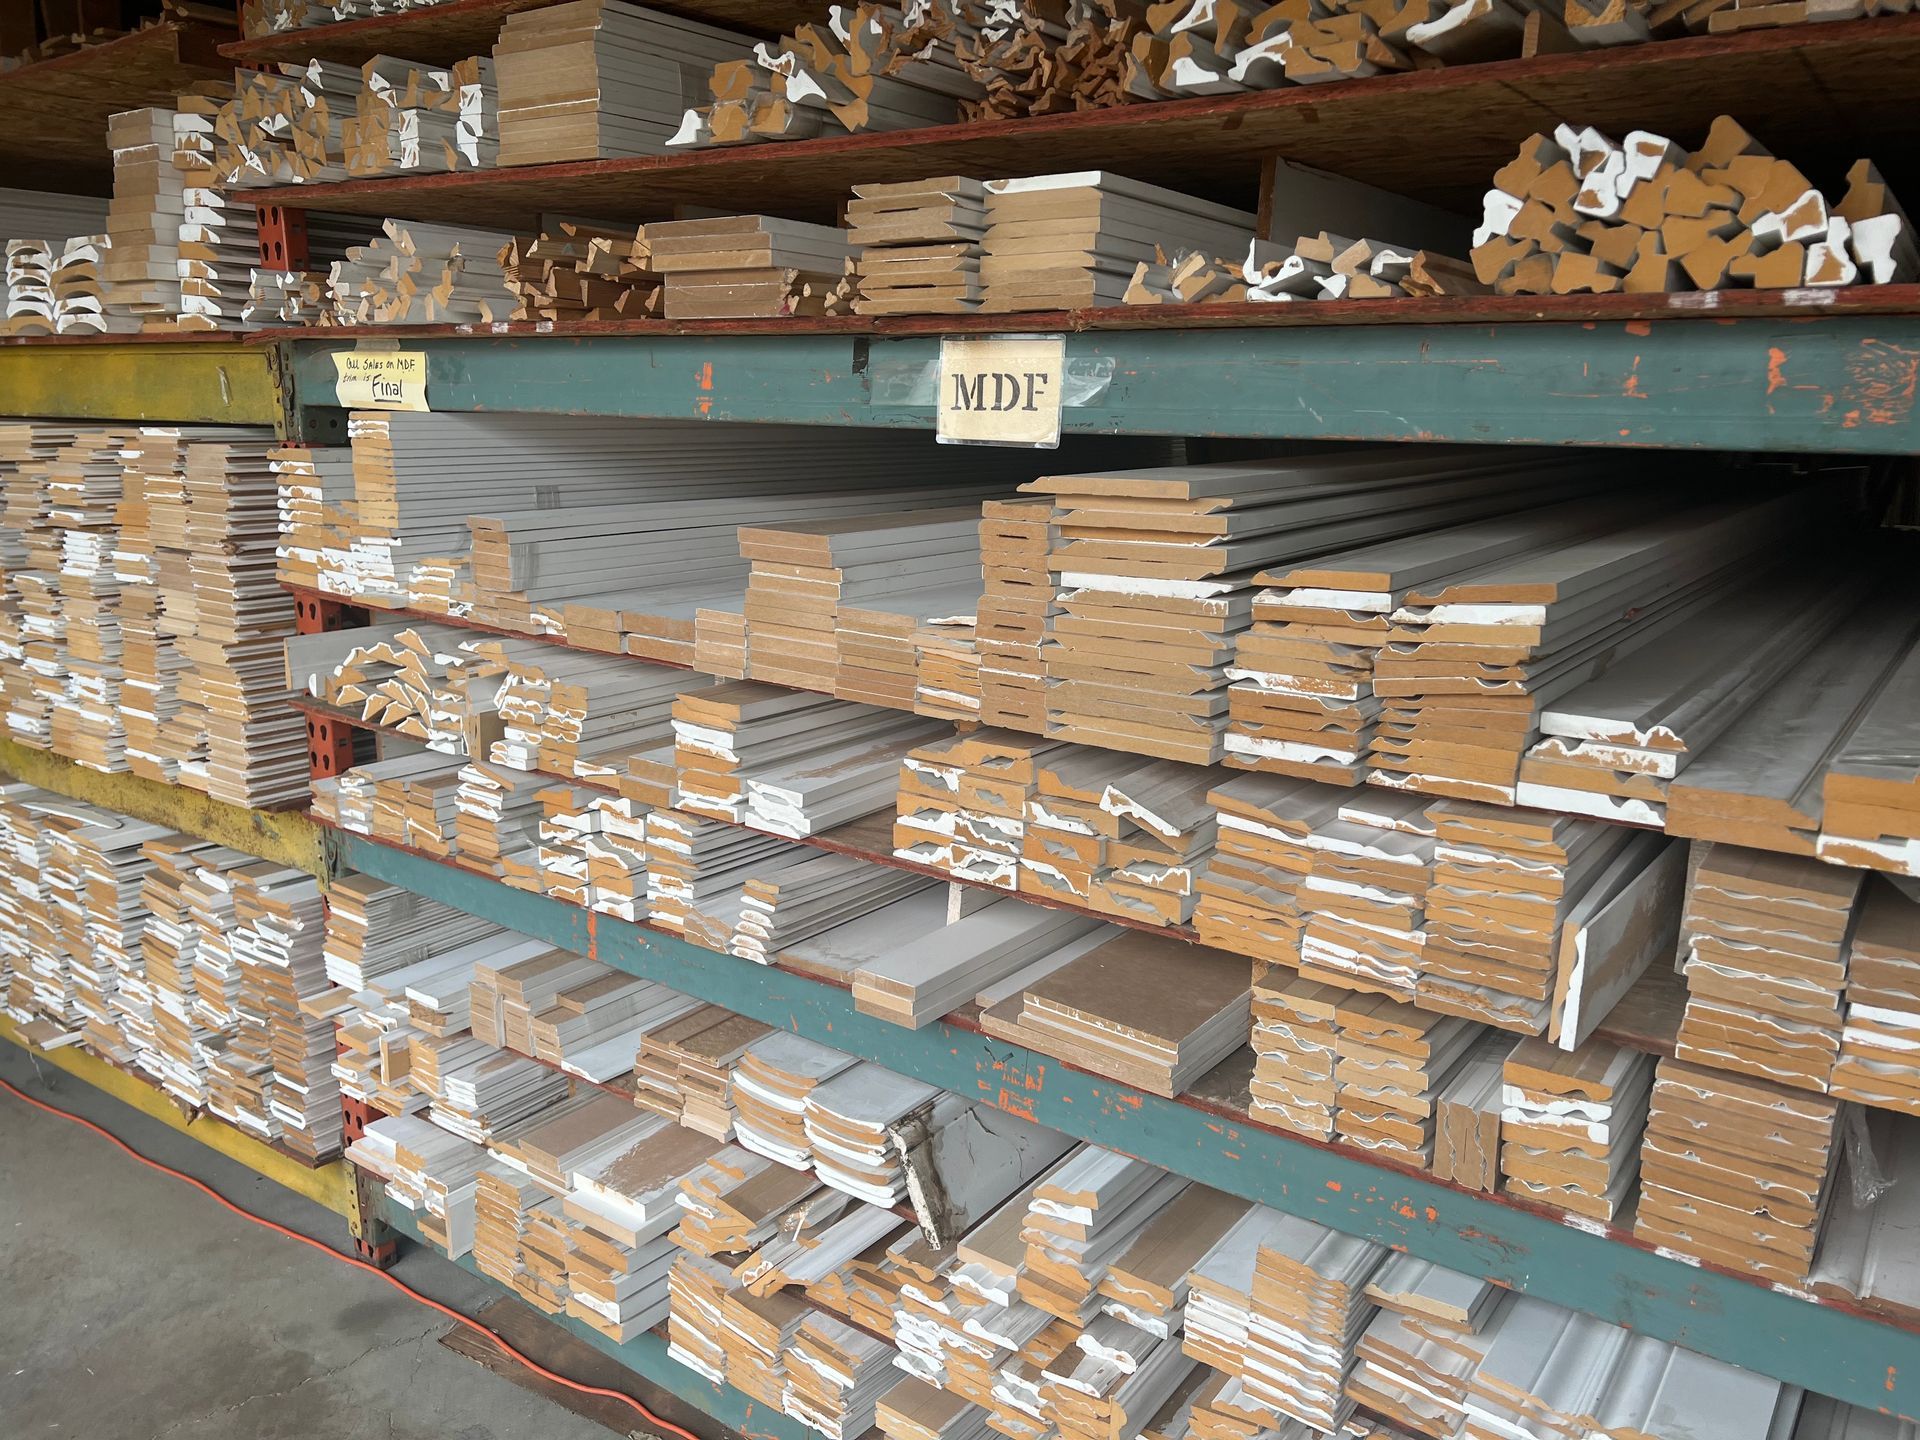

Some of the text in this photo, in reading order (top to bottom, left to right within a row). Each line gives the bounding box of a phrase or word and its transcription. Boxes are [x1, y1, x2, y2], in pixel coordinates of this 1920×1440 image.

[386, 361, 394, 369] on
[343, 373, 357, 382] trim
[372, 374, 402, 397] Final
[951, 373, 1048, 411] MDF
